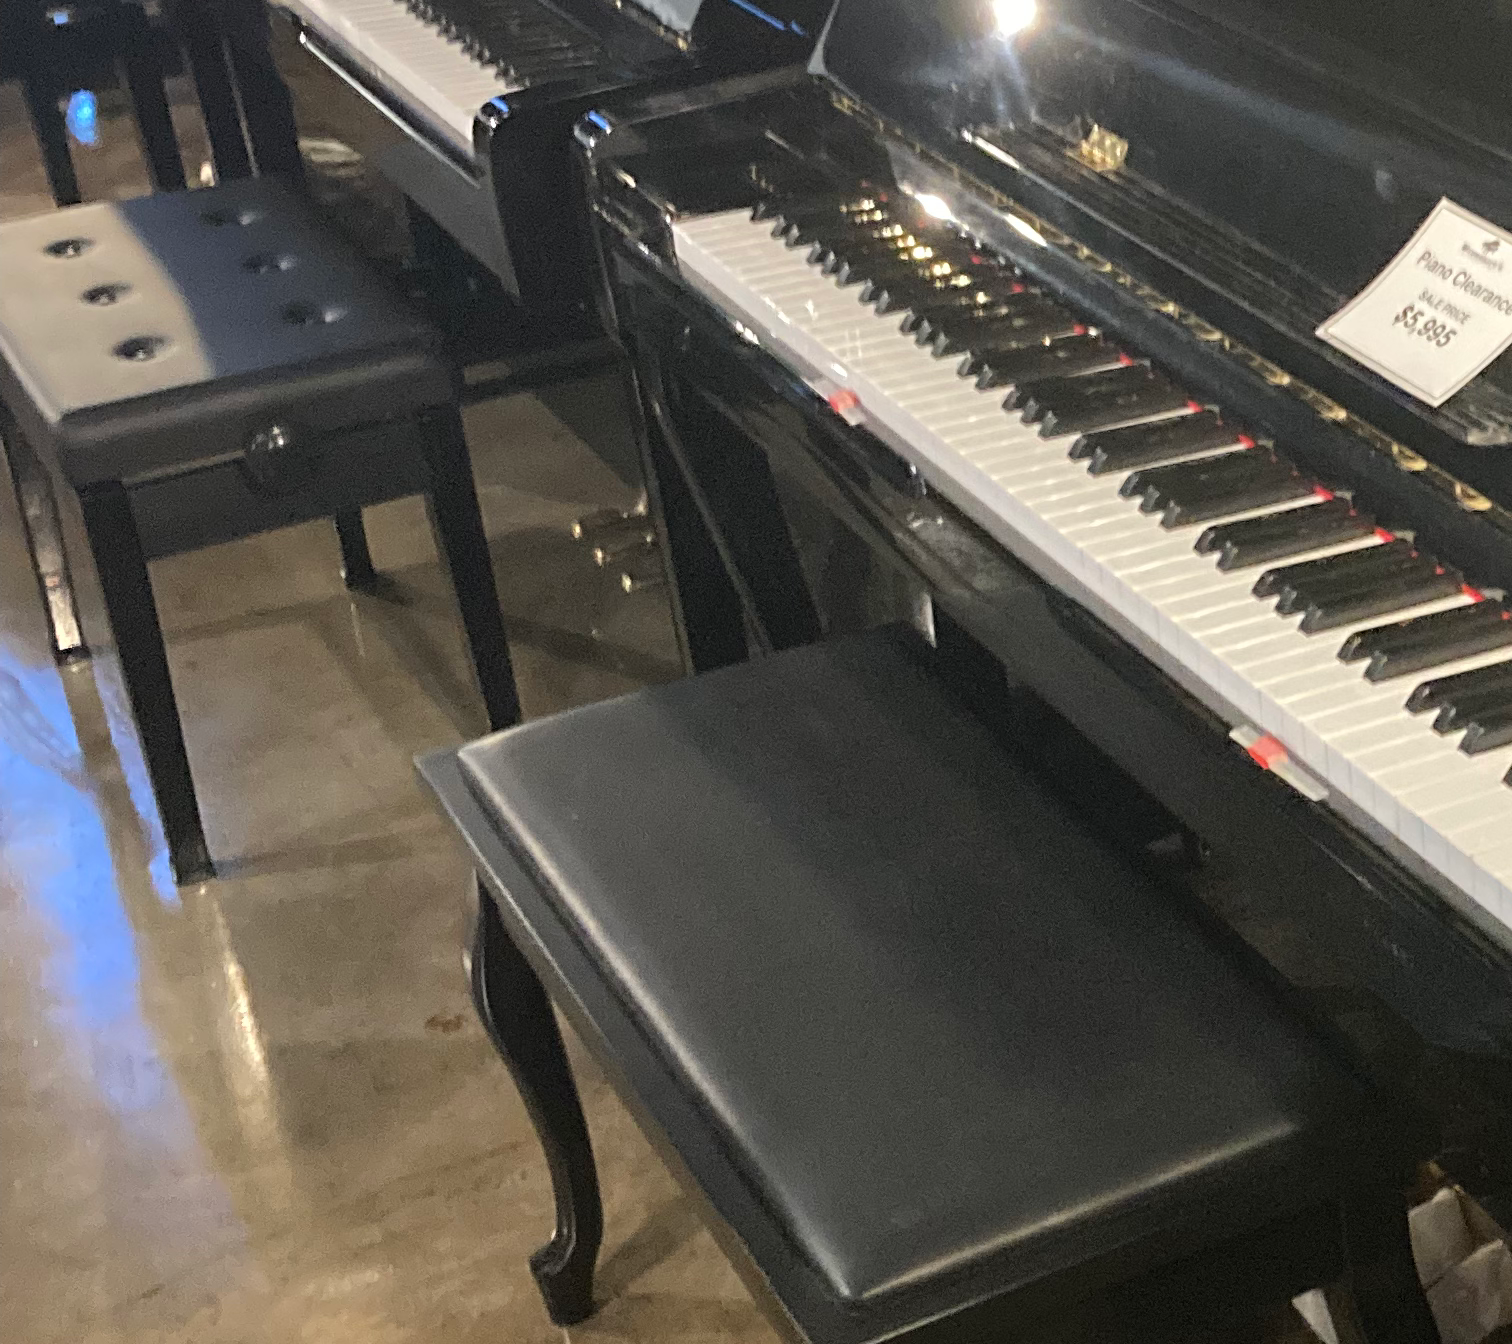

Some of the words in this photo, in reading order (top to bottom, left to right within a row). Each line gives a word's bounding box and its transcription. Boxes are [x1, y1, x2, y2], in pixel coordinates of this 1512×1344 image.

[1416, 250, 1453, 280] Piano
[1418, 288, 1444, 311] SALE
[1441, 302, 1471, 325] PRICE
[1392, 304, 1457, 348] $5,995
